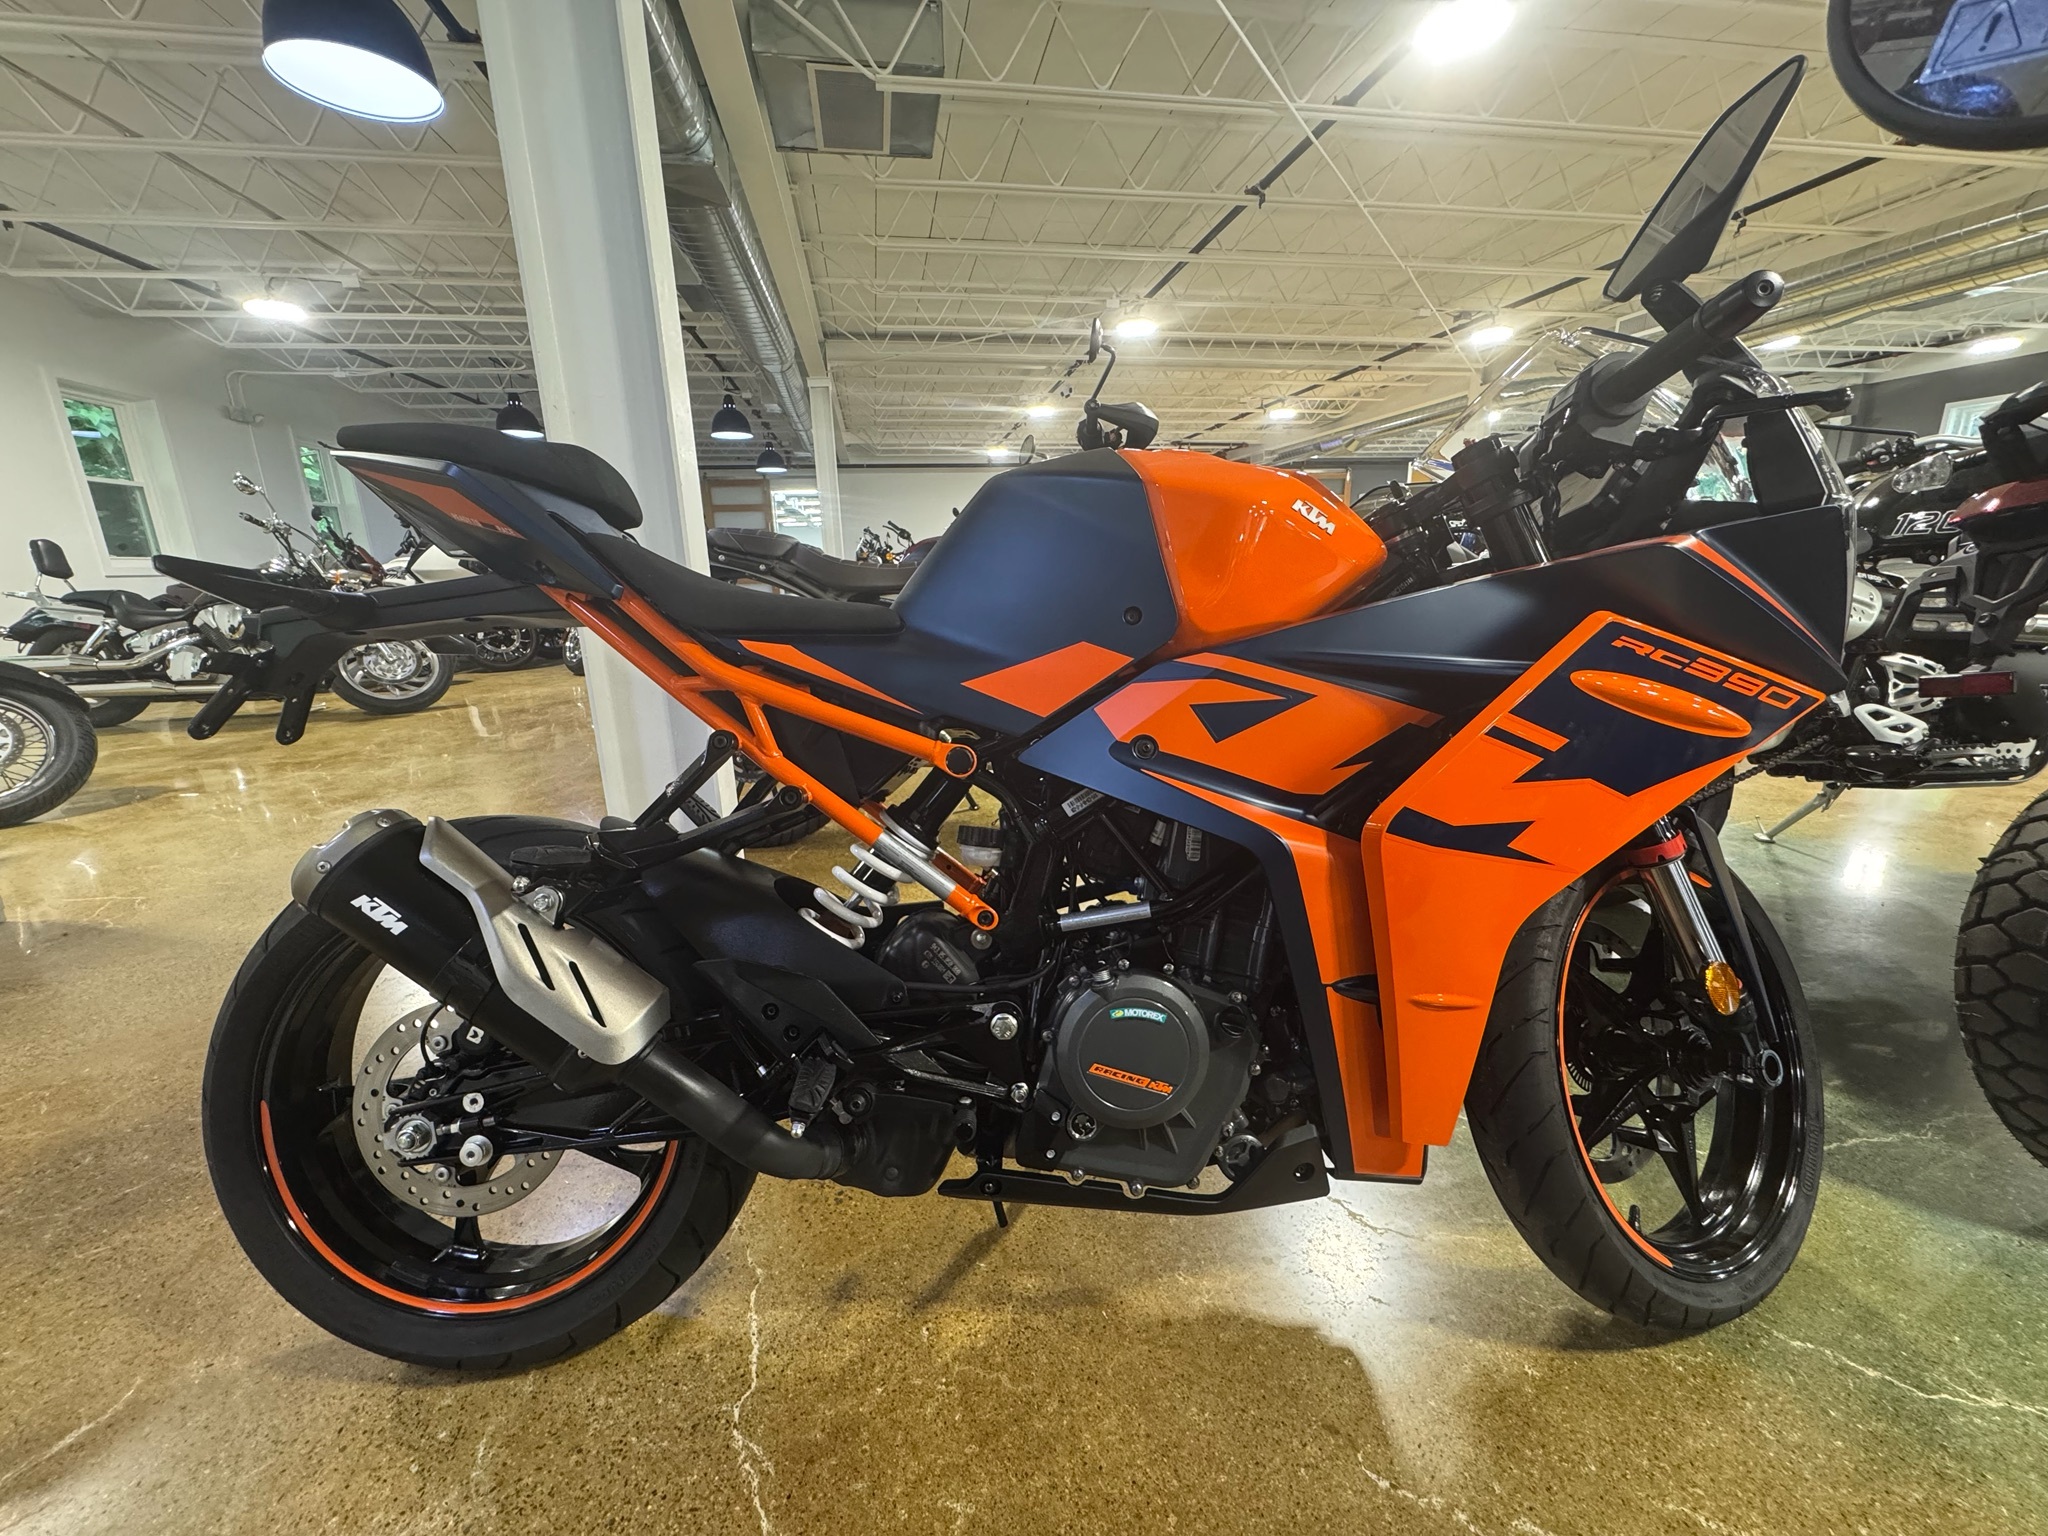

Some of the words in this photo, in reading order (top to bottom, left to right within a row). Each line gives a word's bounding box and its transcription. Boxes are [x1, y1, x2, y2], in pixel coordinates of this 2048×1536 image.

[1291, 499, 1336, 536] KTM
[1611, 635, 1801, 710] RC390
[350, 894, 409, 936] KTM
[1124, 1009, 1165, 1022] MOTOREX
[1094, 1066, 1147, 1085] RACING
[1148, 1080, 1173, 1094] KTM
